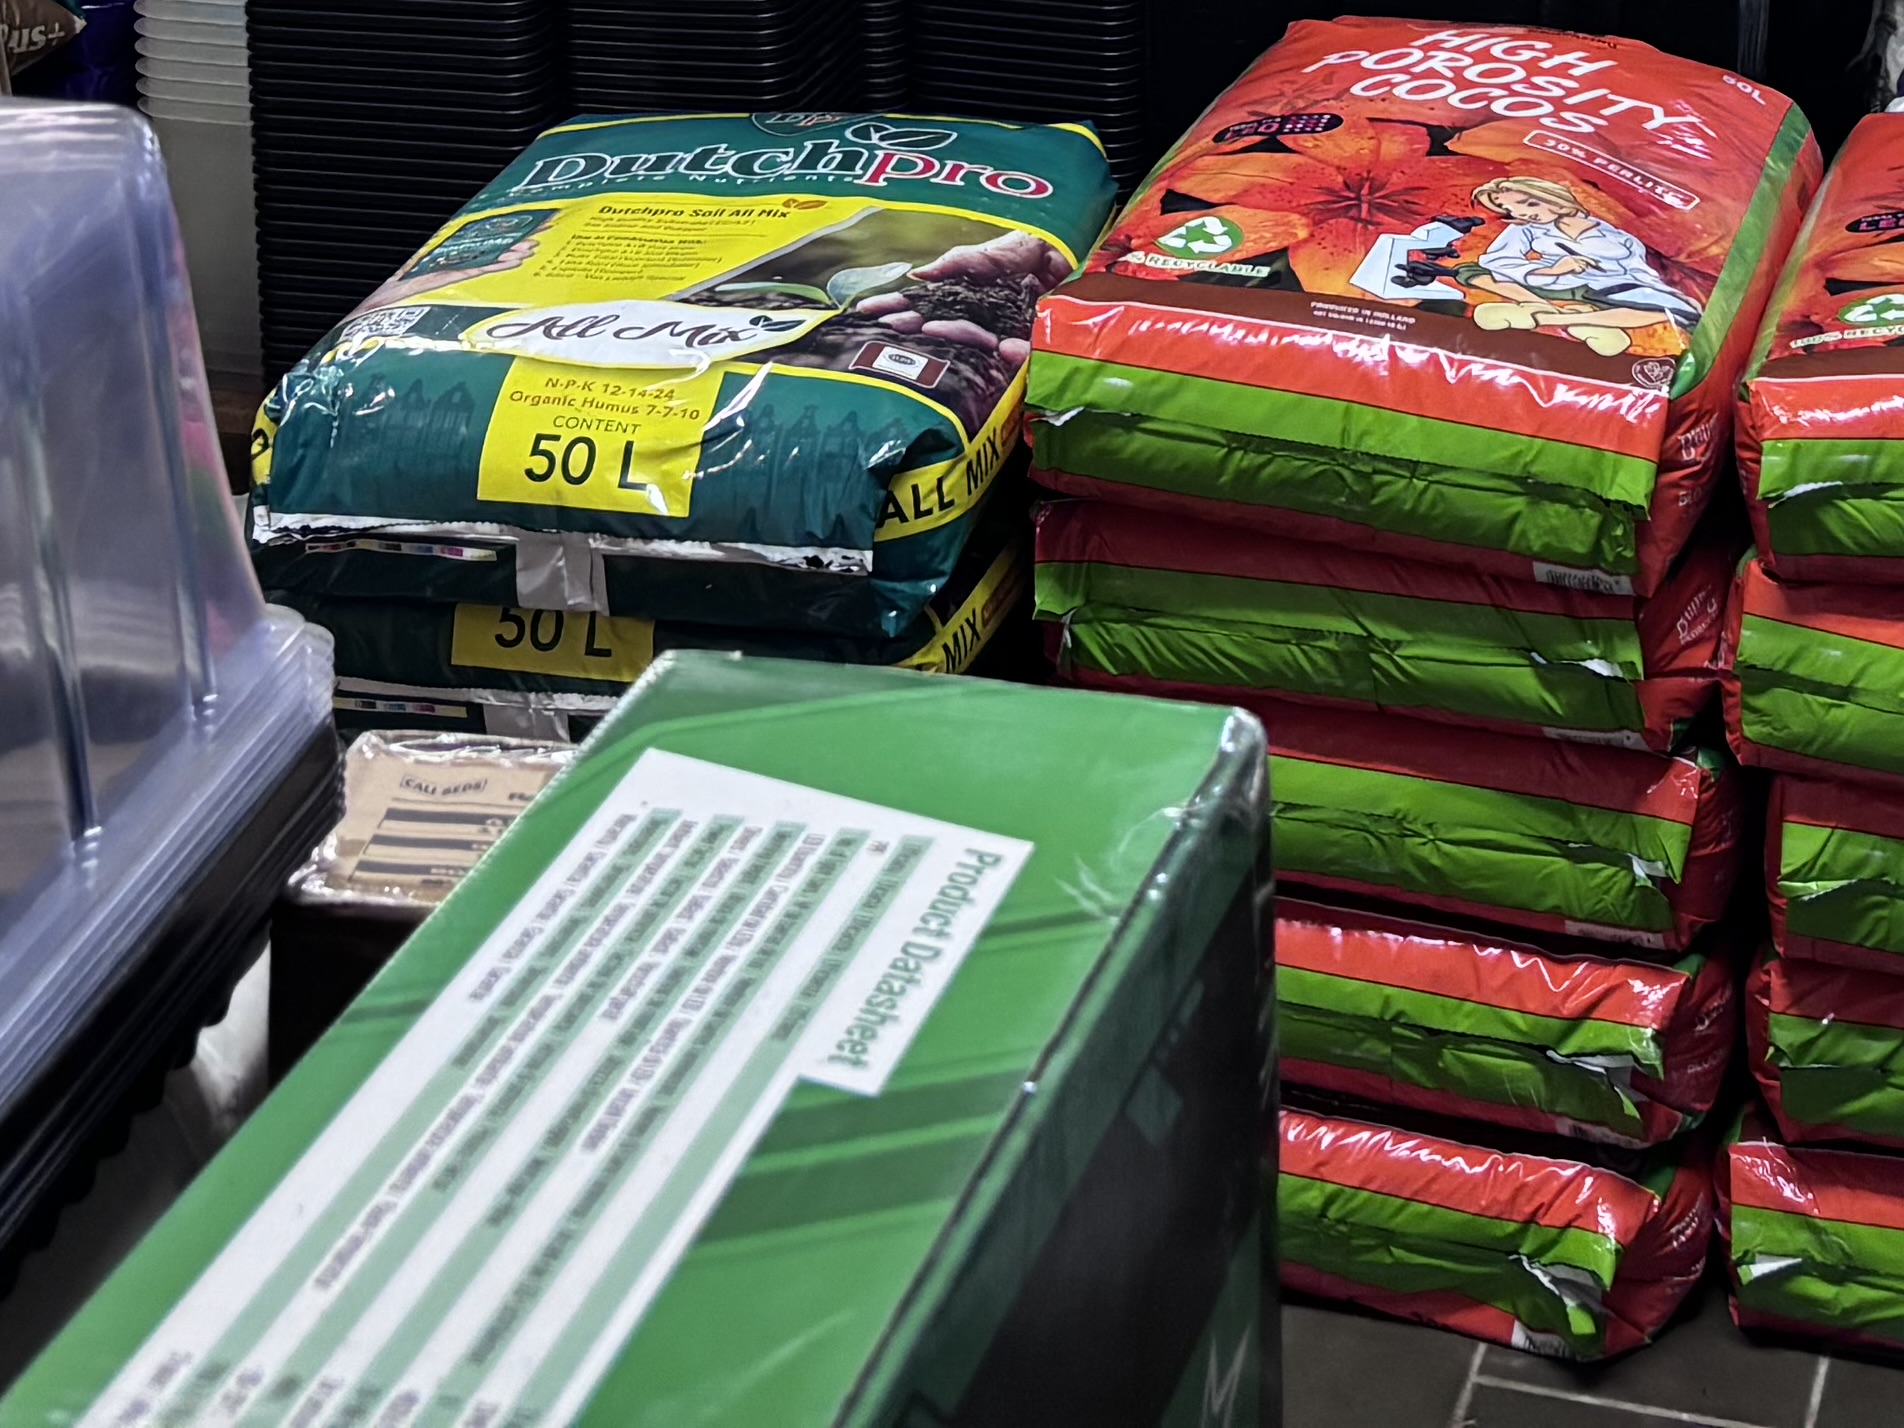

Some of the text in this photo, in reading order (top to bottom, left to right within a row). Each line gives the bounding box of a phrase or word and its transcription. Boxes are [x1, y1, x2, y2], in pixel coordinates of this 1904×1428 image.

[1409, 28, 1620, 78] HIGH
[1301, 47, 1698, 136] POROSITY
[1349, 73, 1610, 134] COCOS
[511, 138, 1053, 198] Dutchpro
[508, 390, 578, 411] Organic
[579, 396, 640, 417] Humus
[552, 414, 642, 436] CONTENT
[523, 432, 650, 492] 50 L
[879, 427, 1001, 528] ALL MIX
[493, 608, 613, 659] 50 L
[940, 615, 984, 675] MIX
[826, 847, 1005, 1069] Product Datasheet
